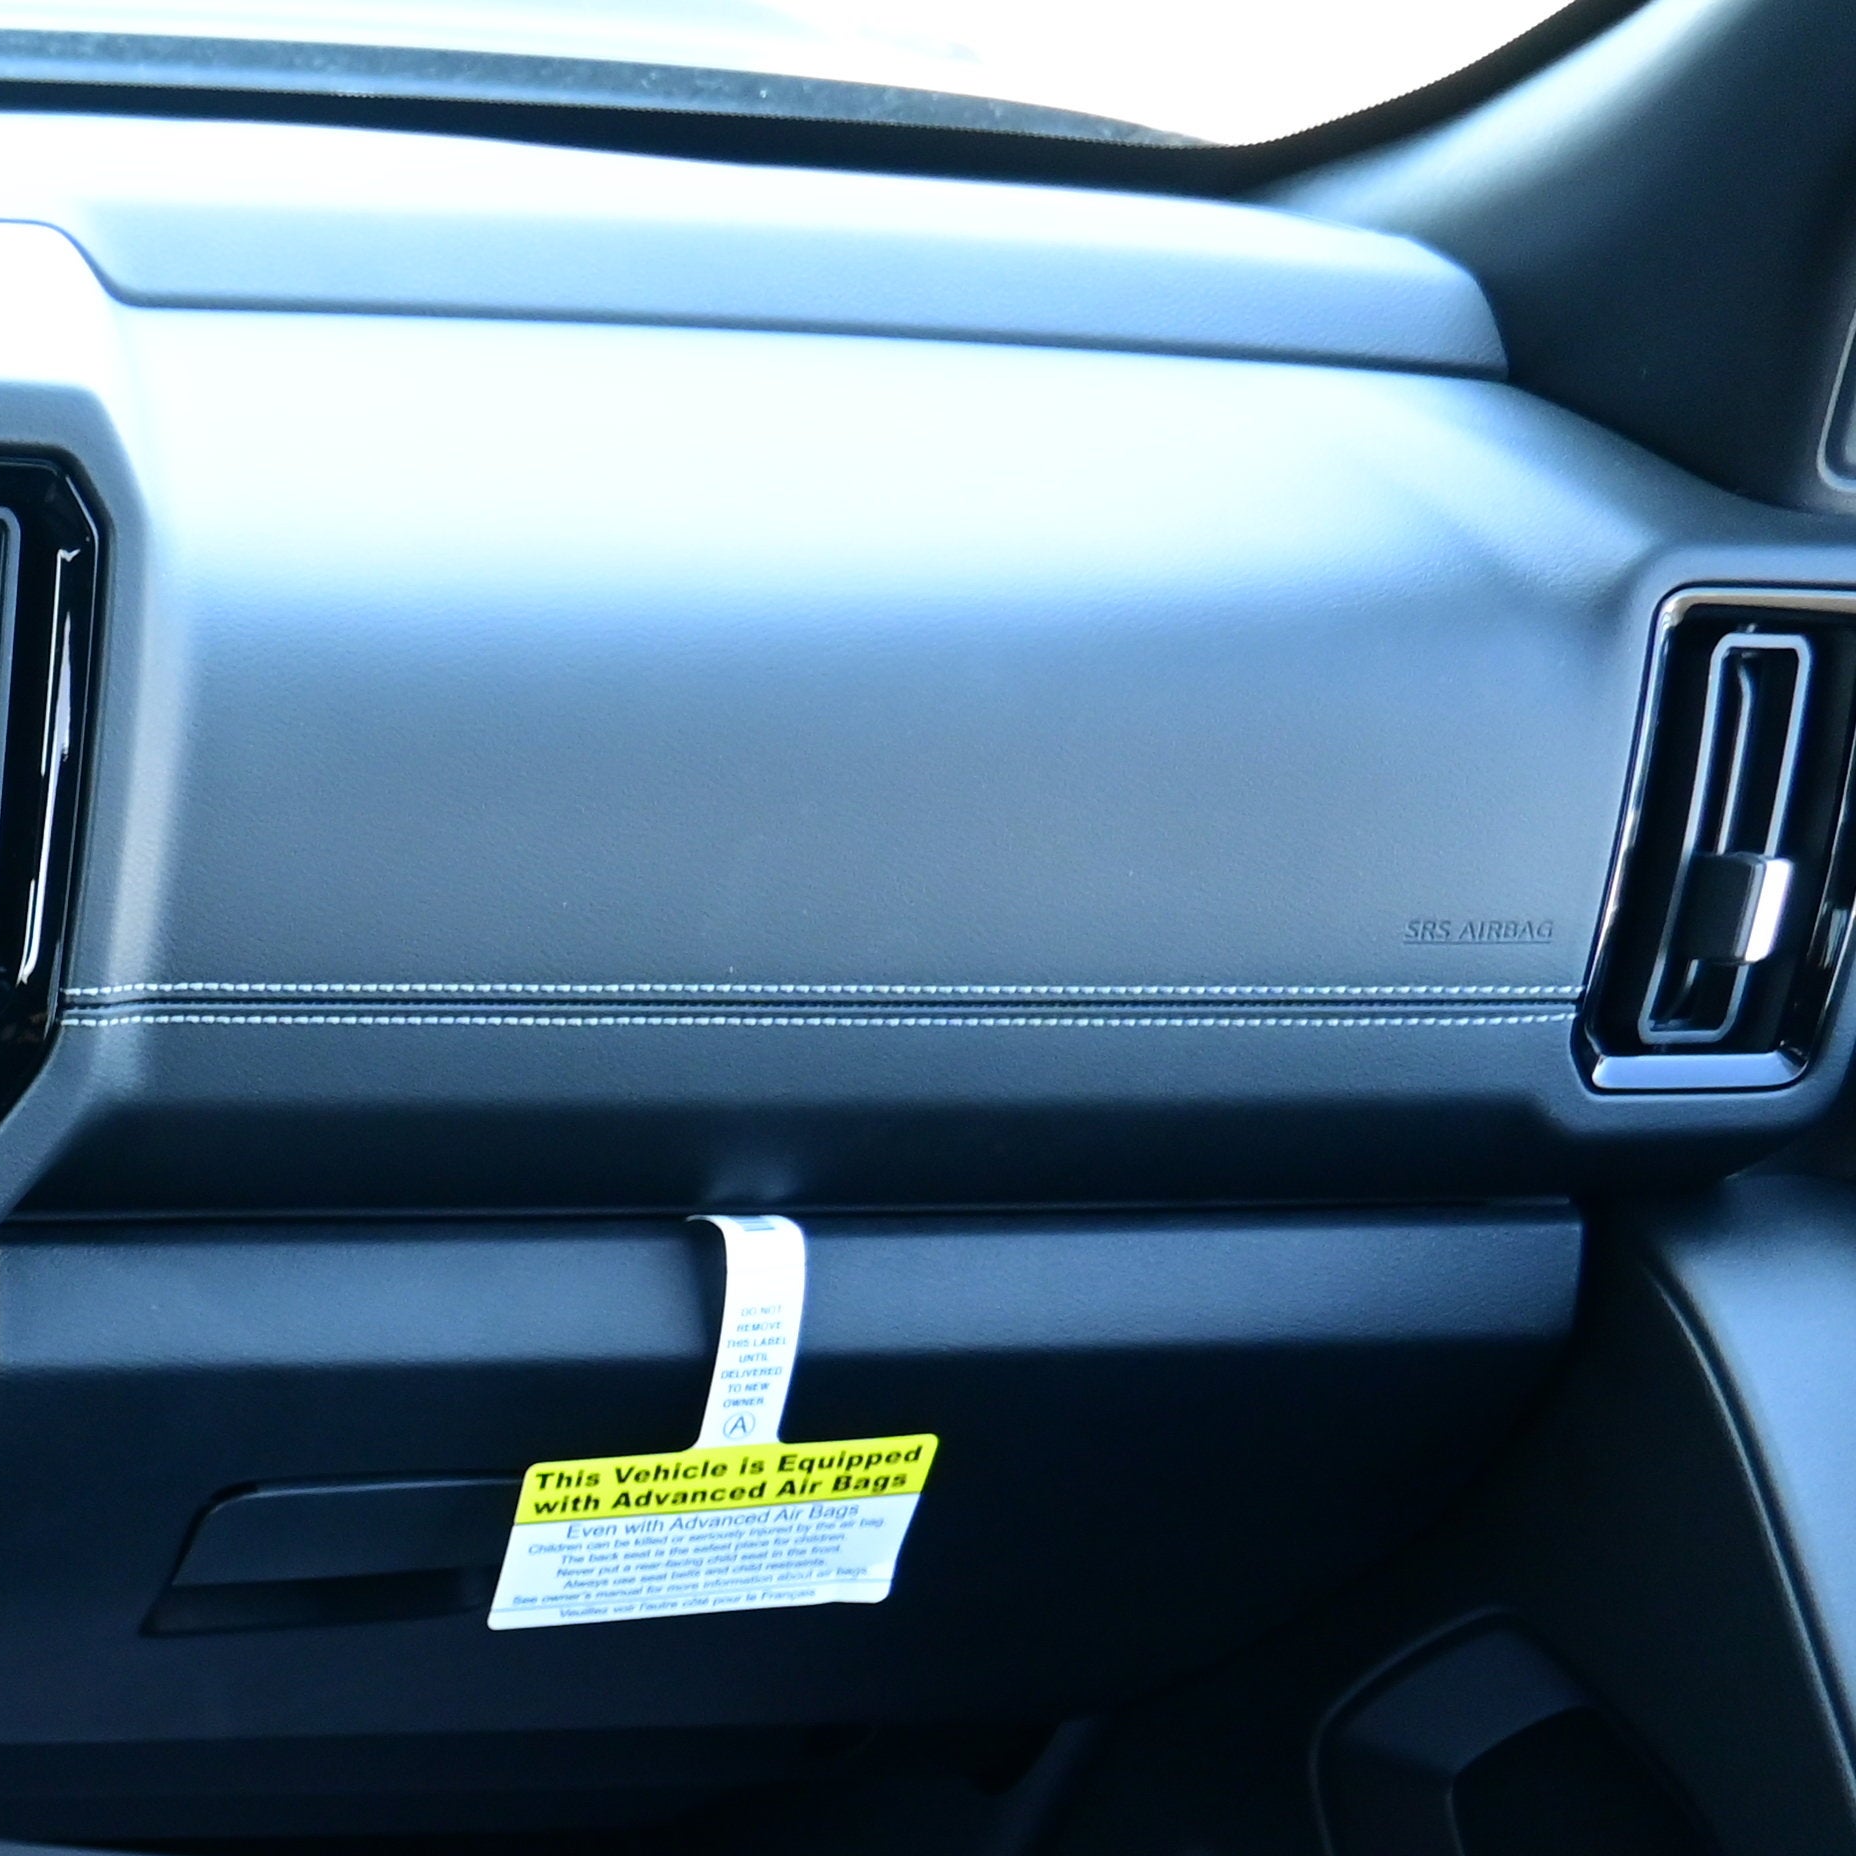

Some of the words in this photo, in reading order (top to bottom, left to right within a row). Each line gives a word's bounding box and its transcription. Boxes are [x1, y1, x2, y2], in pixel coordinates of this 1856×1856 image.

[1404, 920, 1451, 940] SRS
[1459, 920, 1554, 940] AIRBAG
[729, 1415, 746, 1434] A
[536, 1470, 601, 1490] This
[614, 1461, 728, 1485] Vehicle
[739, 1457, 765, 1476] is
[777, 1445, 923, 1474] Equipped
[534, 1494, 600, 1516] with
[612, 1481, 767, 1510] Advanced
[775, 1479, 822, 1498] Air
[831, 1474, 907, 1495] Bags
[567, 1522, 617, 1539] Even
[625, 1519, 665, 1535] with
[669, 1510, 770, 1531] Advanced
[774, 1507, 802, 1522] Air
[809, 1503, 859, 1520] Bags
[528, 1543, 582, 1555] Children
[587, 1541, 609, 1549] can
